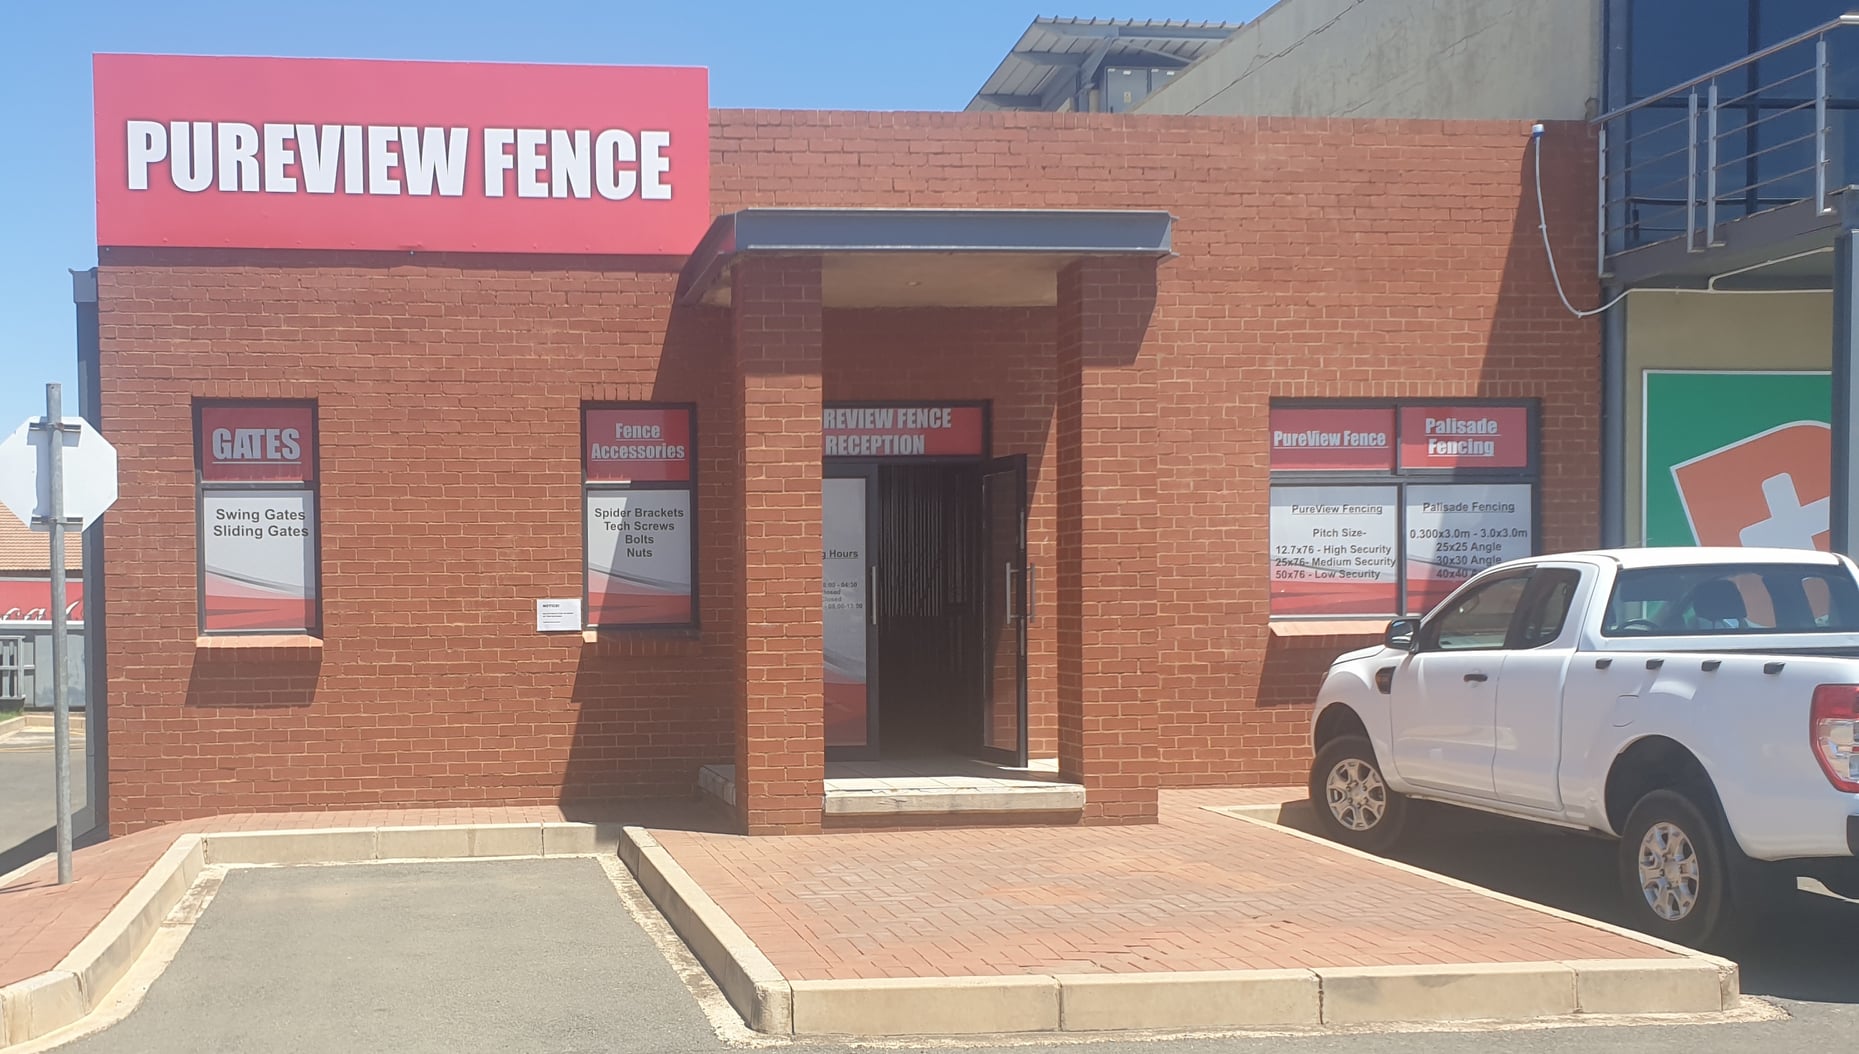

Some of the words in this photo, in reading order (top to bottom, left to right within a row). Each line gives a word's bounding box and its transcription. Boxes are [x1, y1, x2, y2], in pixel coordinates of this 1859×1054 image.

[126, 120, 470, 197] PUREVIEW
[483, 128, 673, 201] FENCE
[823, 407, 894, 429] REVIEW
[897, 407, 952, 429] FENCE
[615, 422, 661, 440] Fence
[1425, 417, 1498, 435] Palisade
[211, 427, 301, 461] GATES
[1273, 430, 1340, 447] PureView
[1343, 430, 1387, 447] Fence
[825, 434, 925, 456] RECEPTION
[1427, 438, 1495, 457] Fencing
[591, 443, 686, 460] Accessories
[594, 507, 632, 520] Spider
[634, 507, 685, 518] Brackets
[1291, 504, 1340, 514] PureView
[1342, 503, 1384, 515] Fencing
[1422, 502, 1469, 513] Palisade
[1472, 502, 1516, 514] Fencing
[215, 508, 260, 523] Swing
[263, 508, 306, 521] Gates
[213, 524, 264, 540] Sliding
[267, 525, 309, 538] Gates
[603, 521, 631, 532] Tech
[633, 521, 675, 532] Screws
[1312, 527, 1339, 538] Pitch
[1409, 528, 1471, 539] 0.300x3.0m
[1480, 527, 1528, 539] 3.0x3.0m
[624, 534, 655, 545] Bolts
[626, 547, 653, 558] Nuts
[829, 549, 859, 558] Hours
[1275, 545, 1315, 555] 12.7x76
[1323, 545, 1348, 556] High
[1350, 544, 1392, 556] Security
[1436, 542, 1468, 552] 25x25
[1470, 542, 1502, 554] Angle
[1311, 557, 1352, 567] Medium
[1354, 556, 1397, 568] Security
[1436, 555, 1468, 565] 30x30
[1470, 556, 1502, 567] Angle
[1275, 570, 1306, 580] 50x76
[1314, 569, 1337, 579] Low
[1338, 569, 1381, 581] Security
[1436, 568, 1468, 579] 40x40
